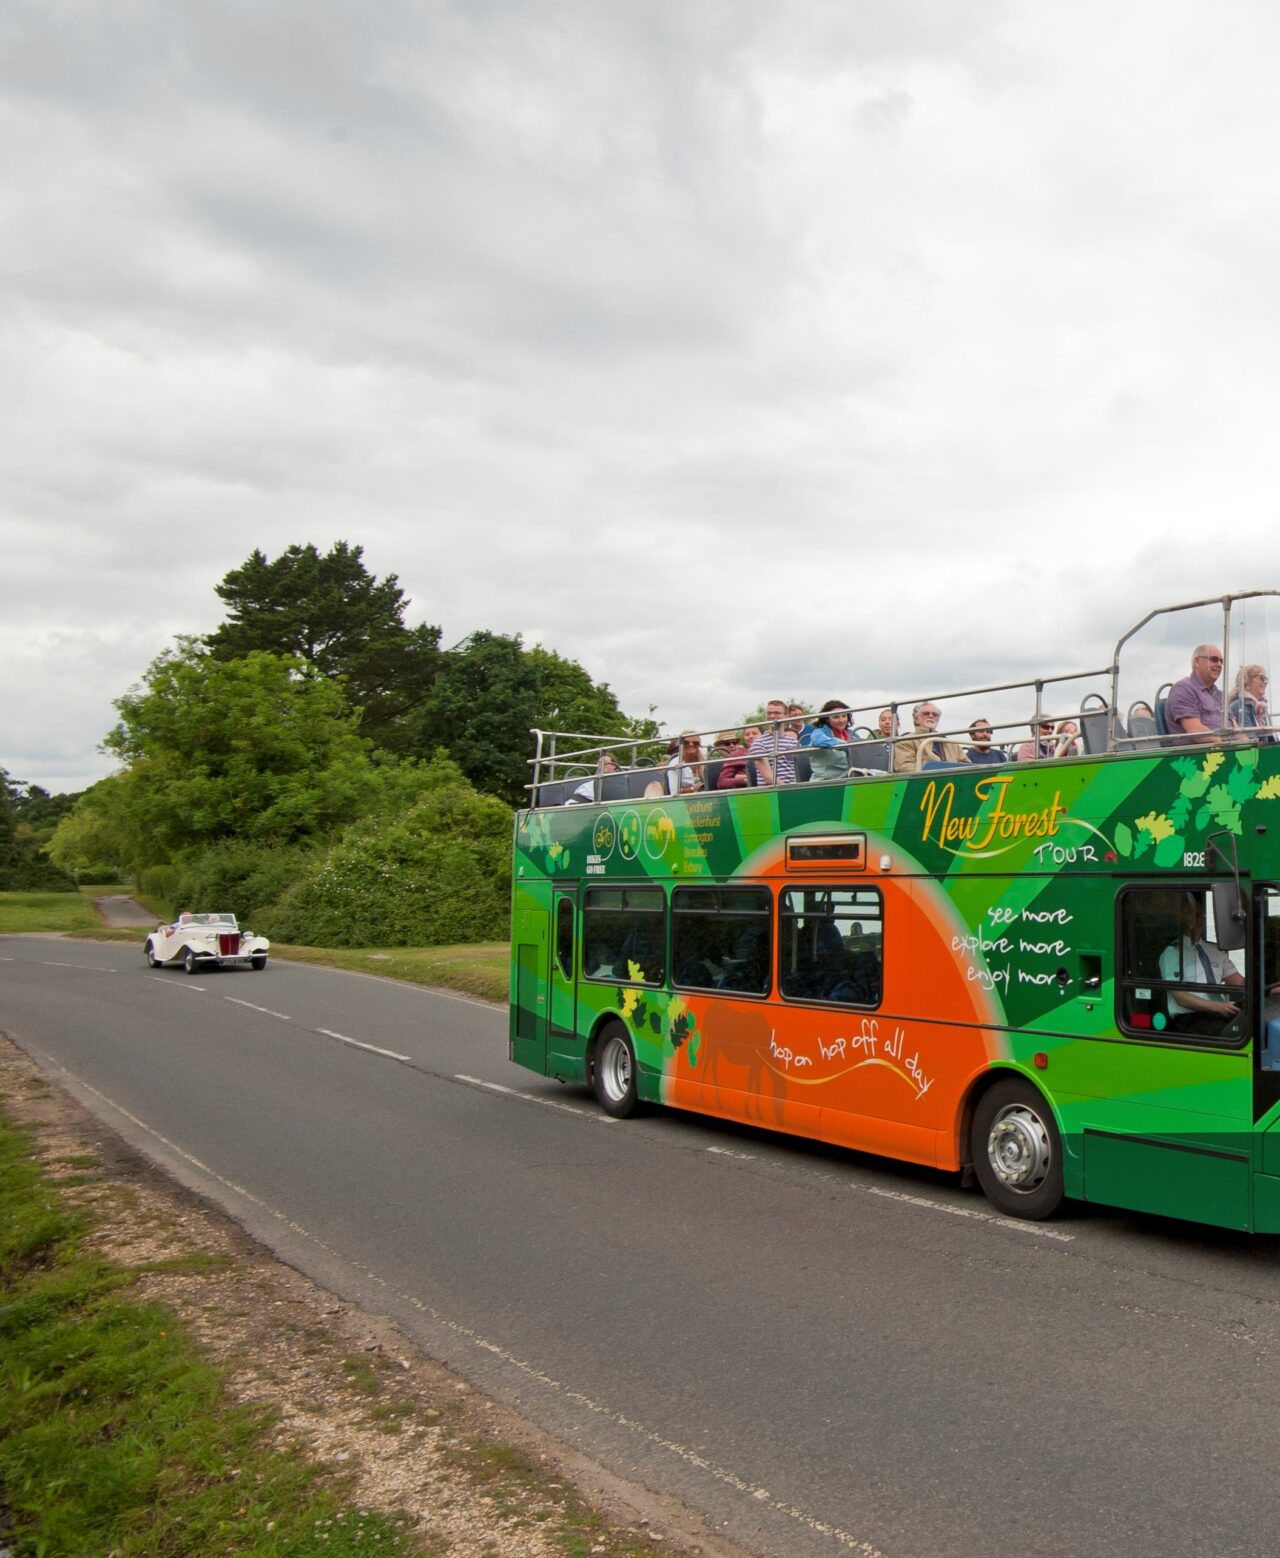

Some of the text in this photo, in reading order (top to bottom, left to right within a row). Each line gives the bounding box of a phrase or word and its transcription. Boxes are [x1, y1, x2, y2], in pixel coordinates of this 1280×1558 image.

[920, 776, 1062, 849] New Forest
[1033, 842, 1099, 864] TOUR
[987, 906, 1073, 927] see more
[951, 923, 1072, 959] explore more
[967, 958, 1073, 996] enjoy mor
[769, 1018, 936, 1101] hop on hop off all day
